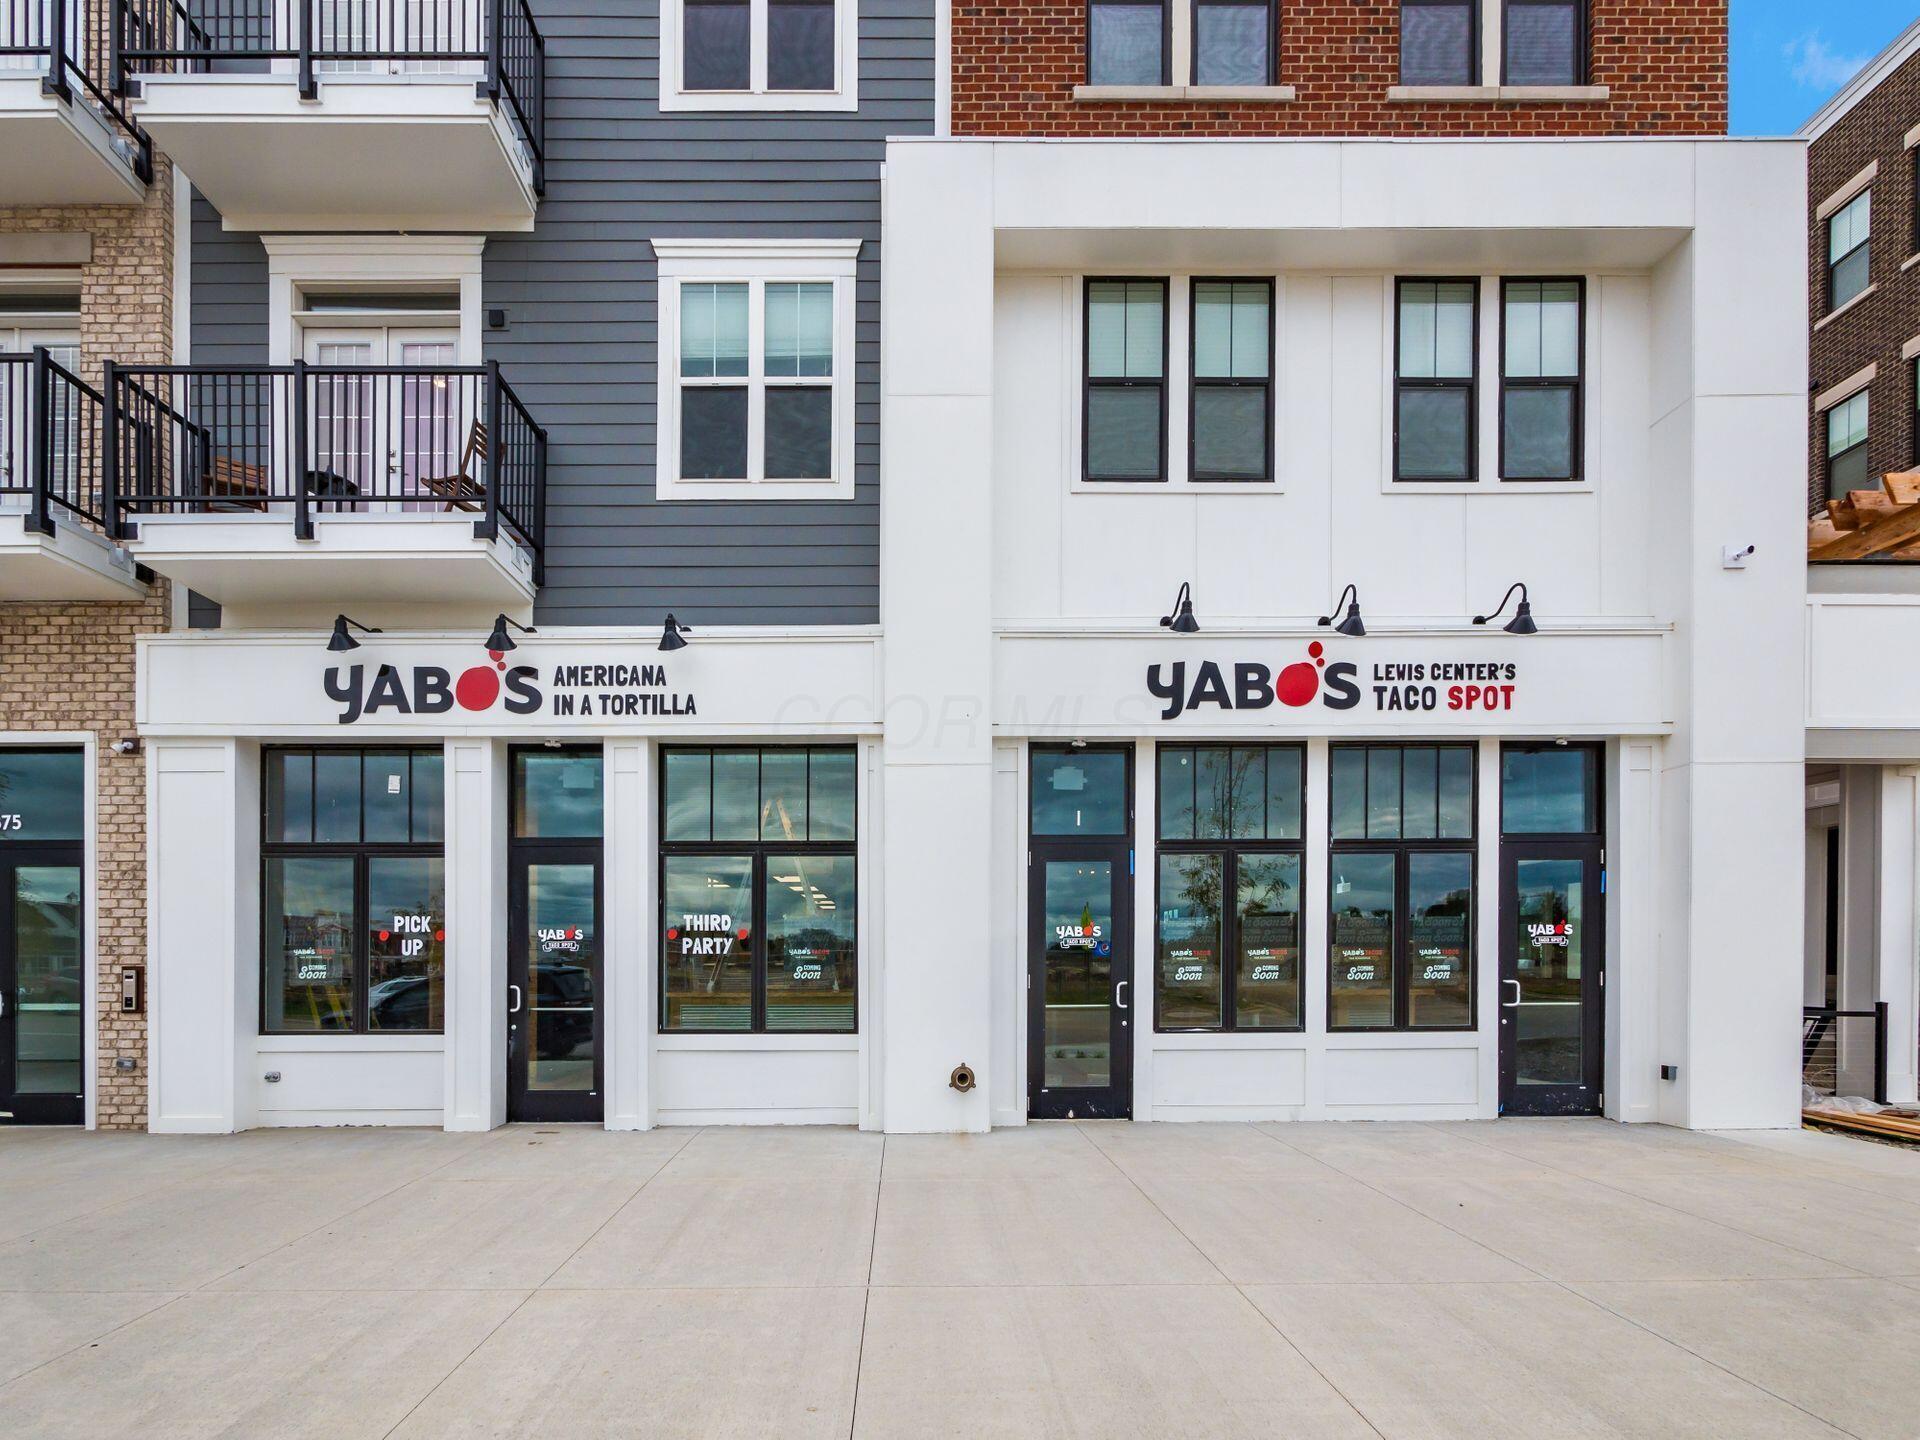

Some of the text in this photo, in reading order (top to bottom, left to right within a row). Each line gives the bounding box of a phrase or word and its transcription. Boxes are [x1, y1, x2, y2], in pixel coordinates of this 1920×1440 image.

[553, 665, 667, 687] AMERICANA
[1373, 663, 1516, 681] LEWIS CENTER'S
[553, 694, 697, 716] IN A TORTILLA
[1373, 685, 1515, 711] TACO SPOT
[0, 814, 22, 831] 75
[393, 915, 431, 933] PICK
[683, 914, 732, 932] THIRD
[401, 939, 424, 956] UP
[682, 937, 733, 954] PARTY
[298, 965, 327, 979] Soon
[793, 965, 821, 979] Soon
[1175, 967, 1202, 981] Soon
[1252, 966, 1279, 980] Soon
[1347, 966, 1375, 980] Soon
[1423, 965, 1451, 979] Soon
